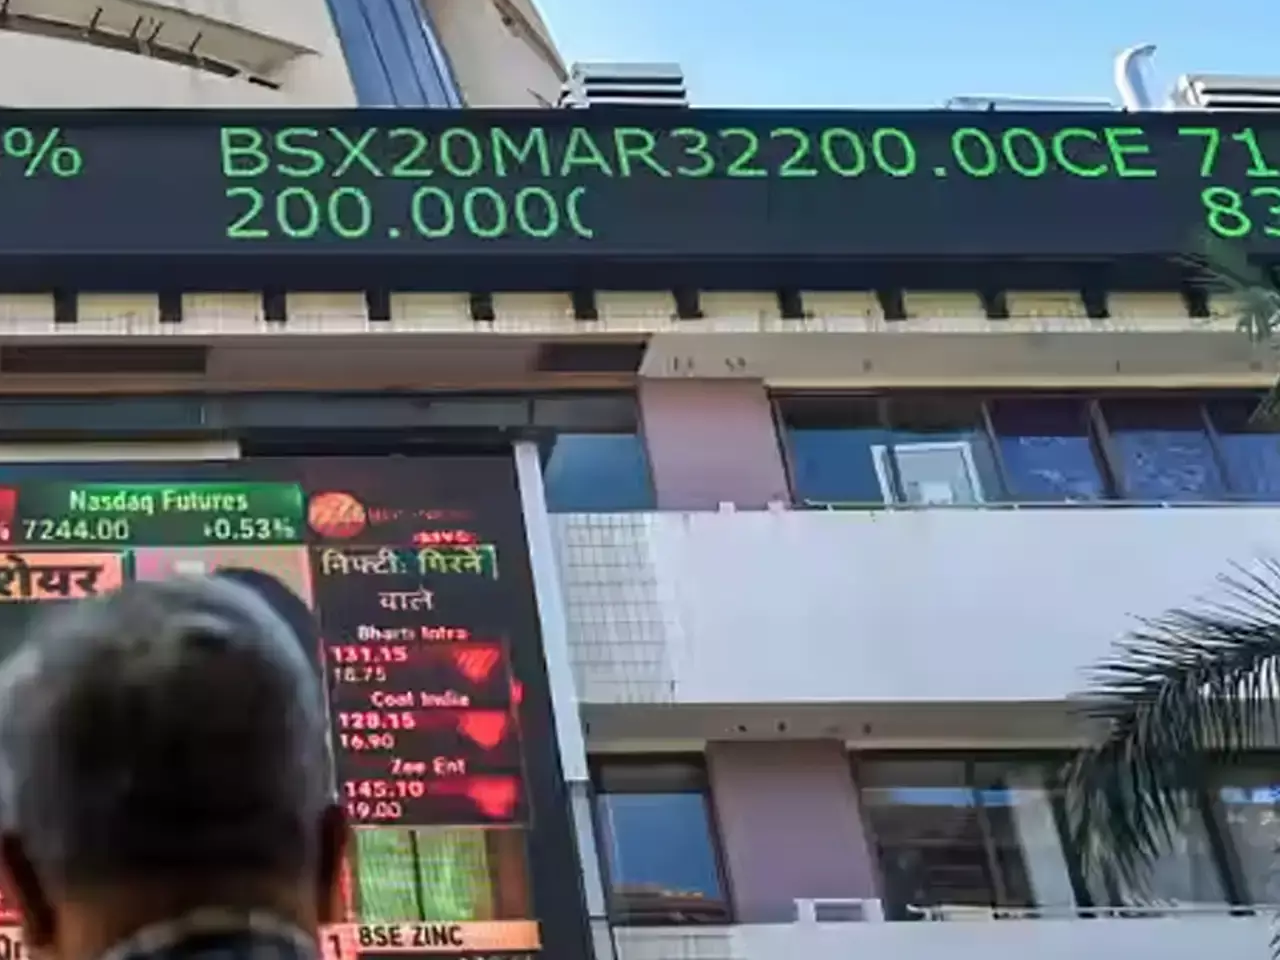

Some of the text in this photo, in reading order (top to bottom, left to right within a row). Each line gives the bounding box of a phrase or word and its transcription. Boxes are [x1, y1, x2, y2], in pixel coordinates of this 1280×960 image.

[220, 126, 1158, 178] BSX20MAR32200.00CE
[70, 490, 248, 515] Nasdaq Futures
[22, 518, 295, 540] 7244.00 +0.53%
[359, 925, 464, 947] BSE ZINC
